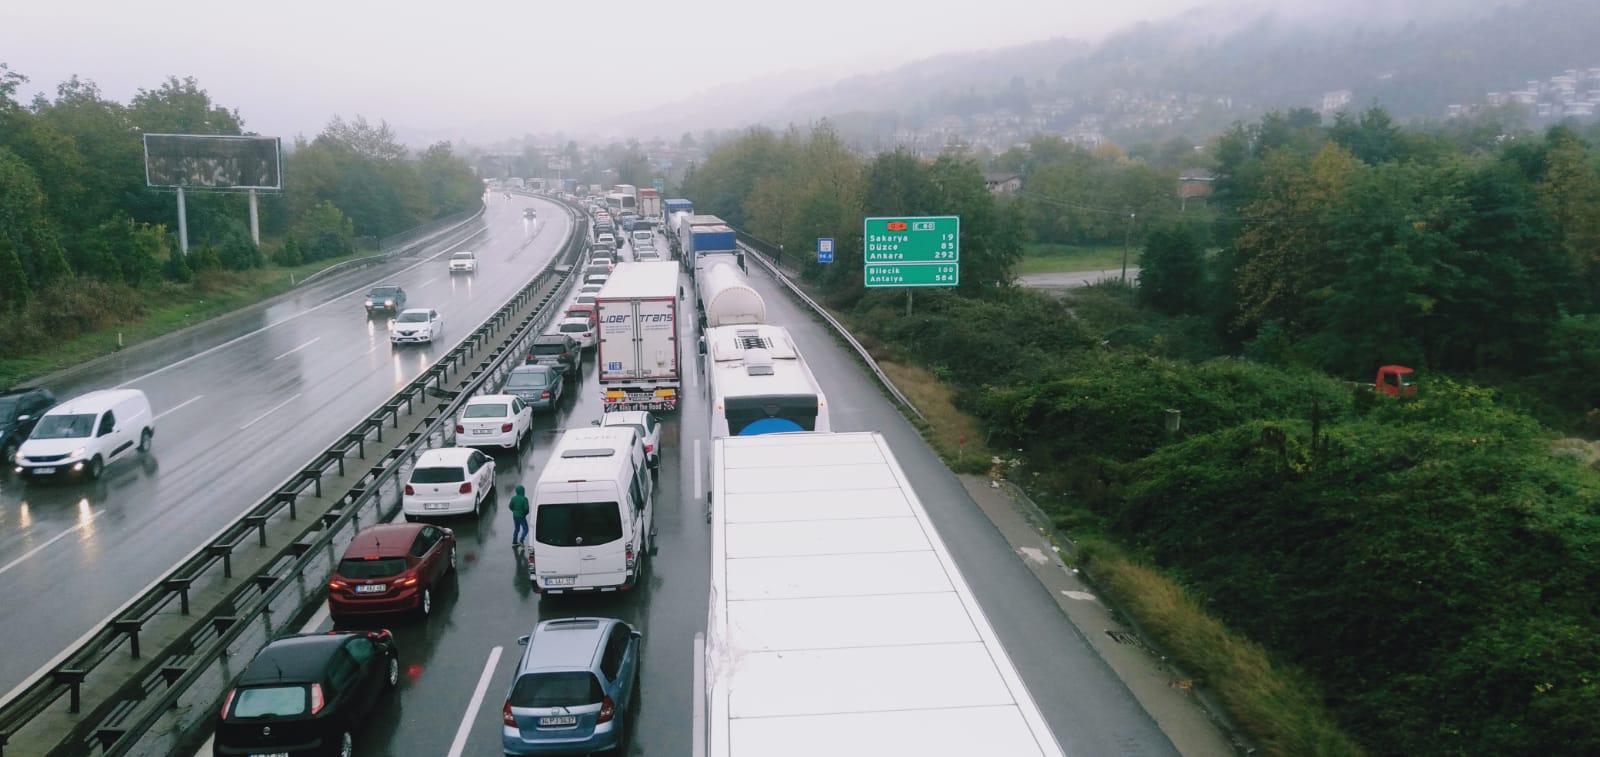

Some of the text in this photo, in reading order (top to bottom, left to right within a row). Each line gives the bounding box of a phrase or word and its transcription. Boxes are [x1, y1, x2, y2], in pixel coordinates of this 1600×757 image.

[869, 233, 954, 243] Sakarya 19
[869, 243, 898, 251] Düzce
[869, 251, 954, 260] Ankara 292
